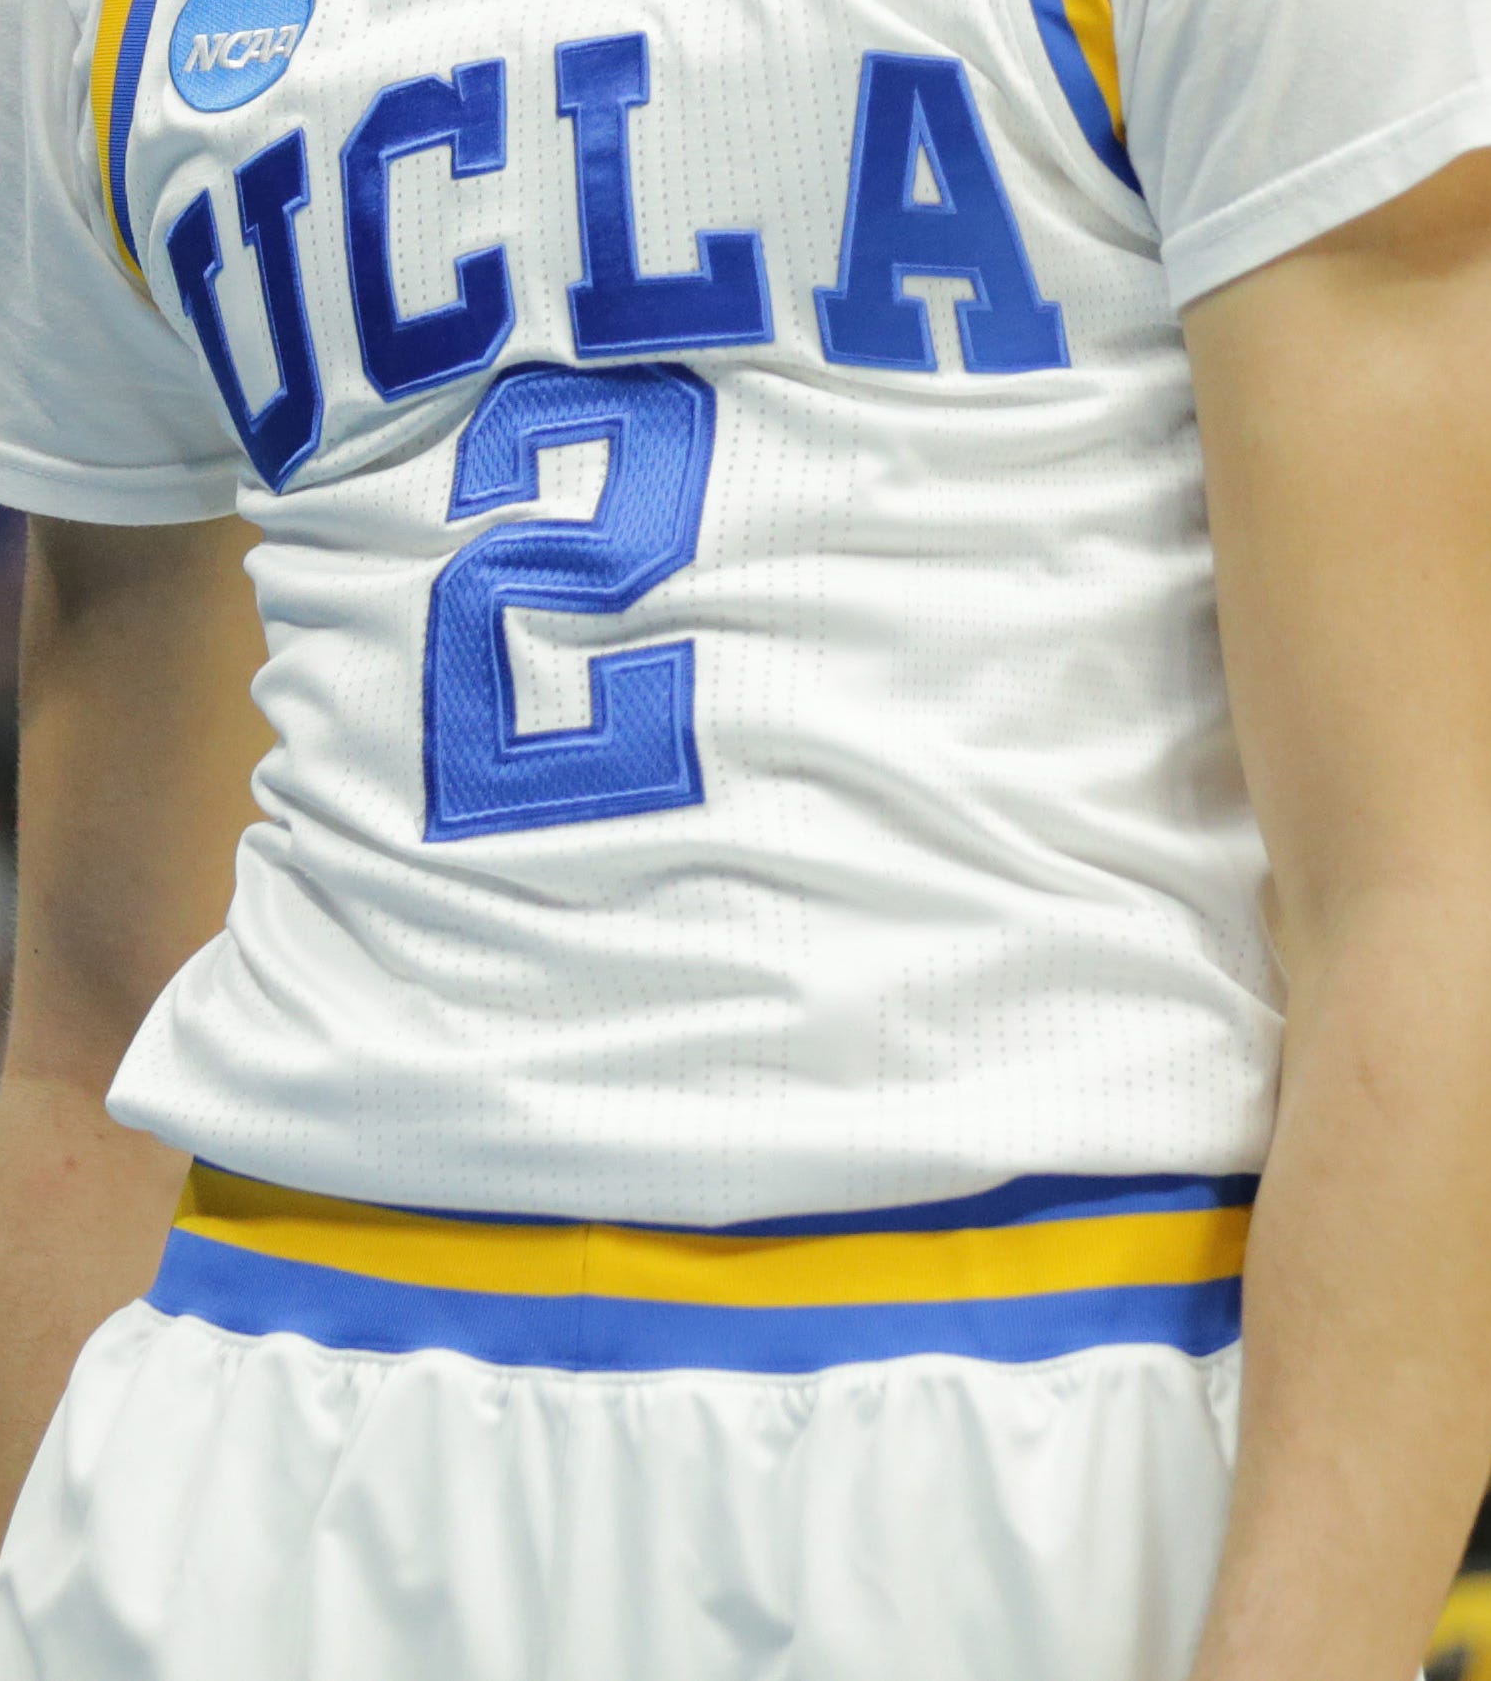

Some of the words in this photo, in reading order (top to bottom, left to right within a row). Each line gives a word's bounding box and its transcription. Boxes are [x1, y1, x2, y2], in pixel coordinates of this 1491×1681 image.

[165, 32, 1071, 494] UCLA
[182, 23, 302, 73] NCAA
[422, 360, 716, 844] 2
